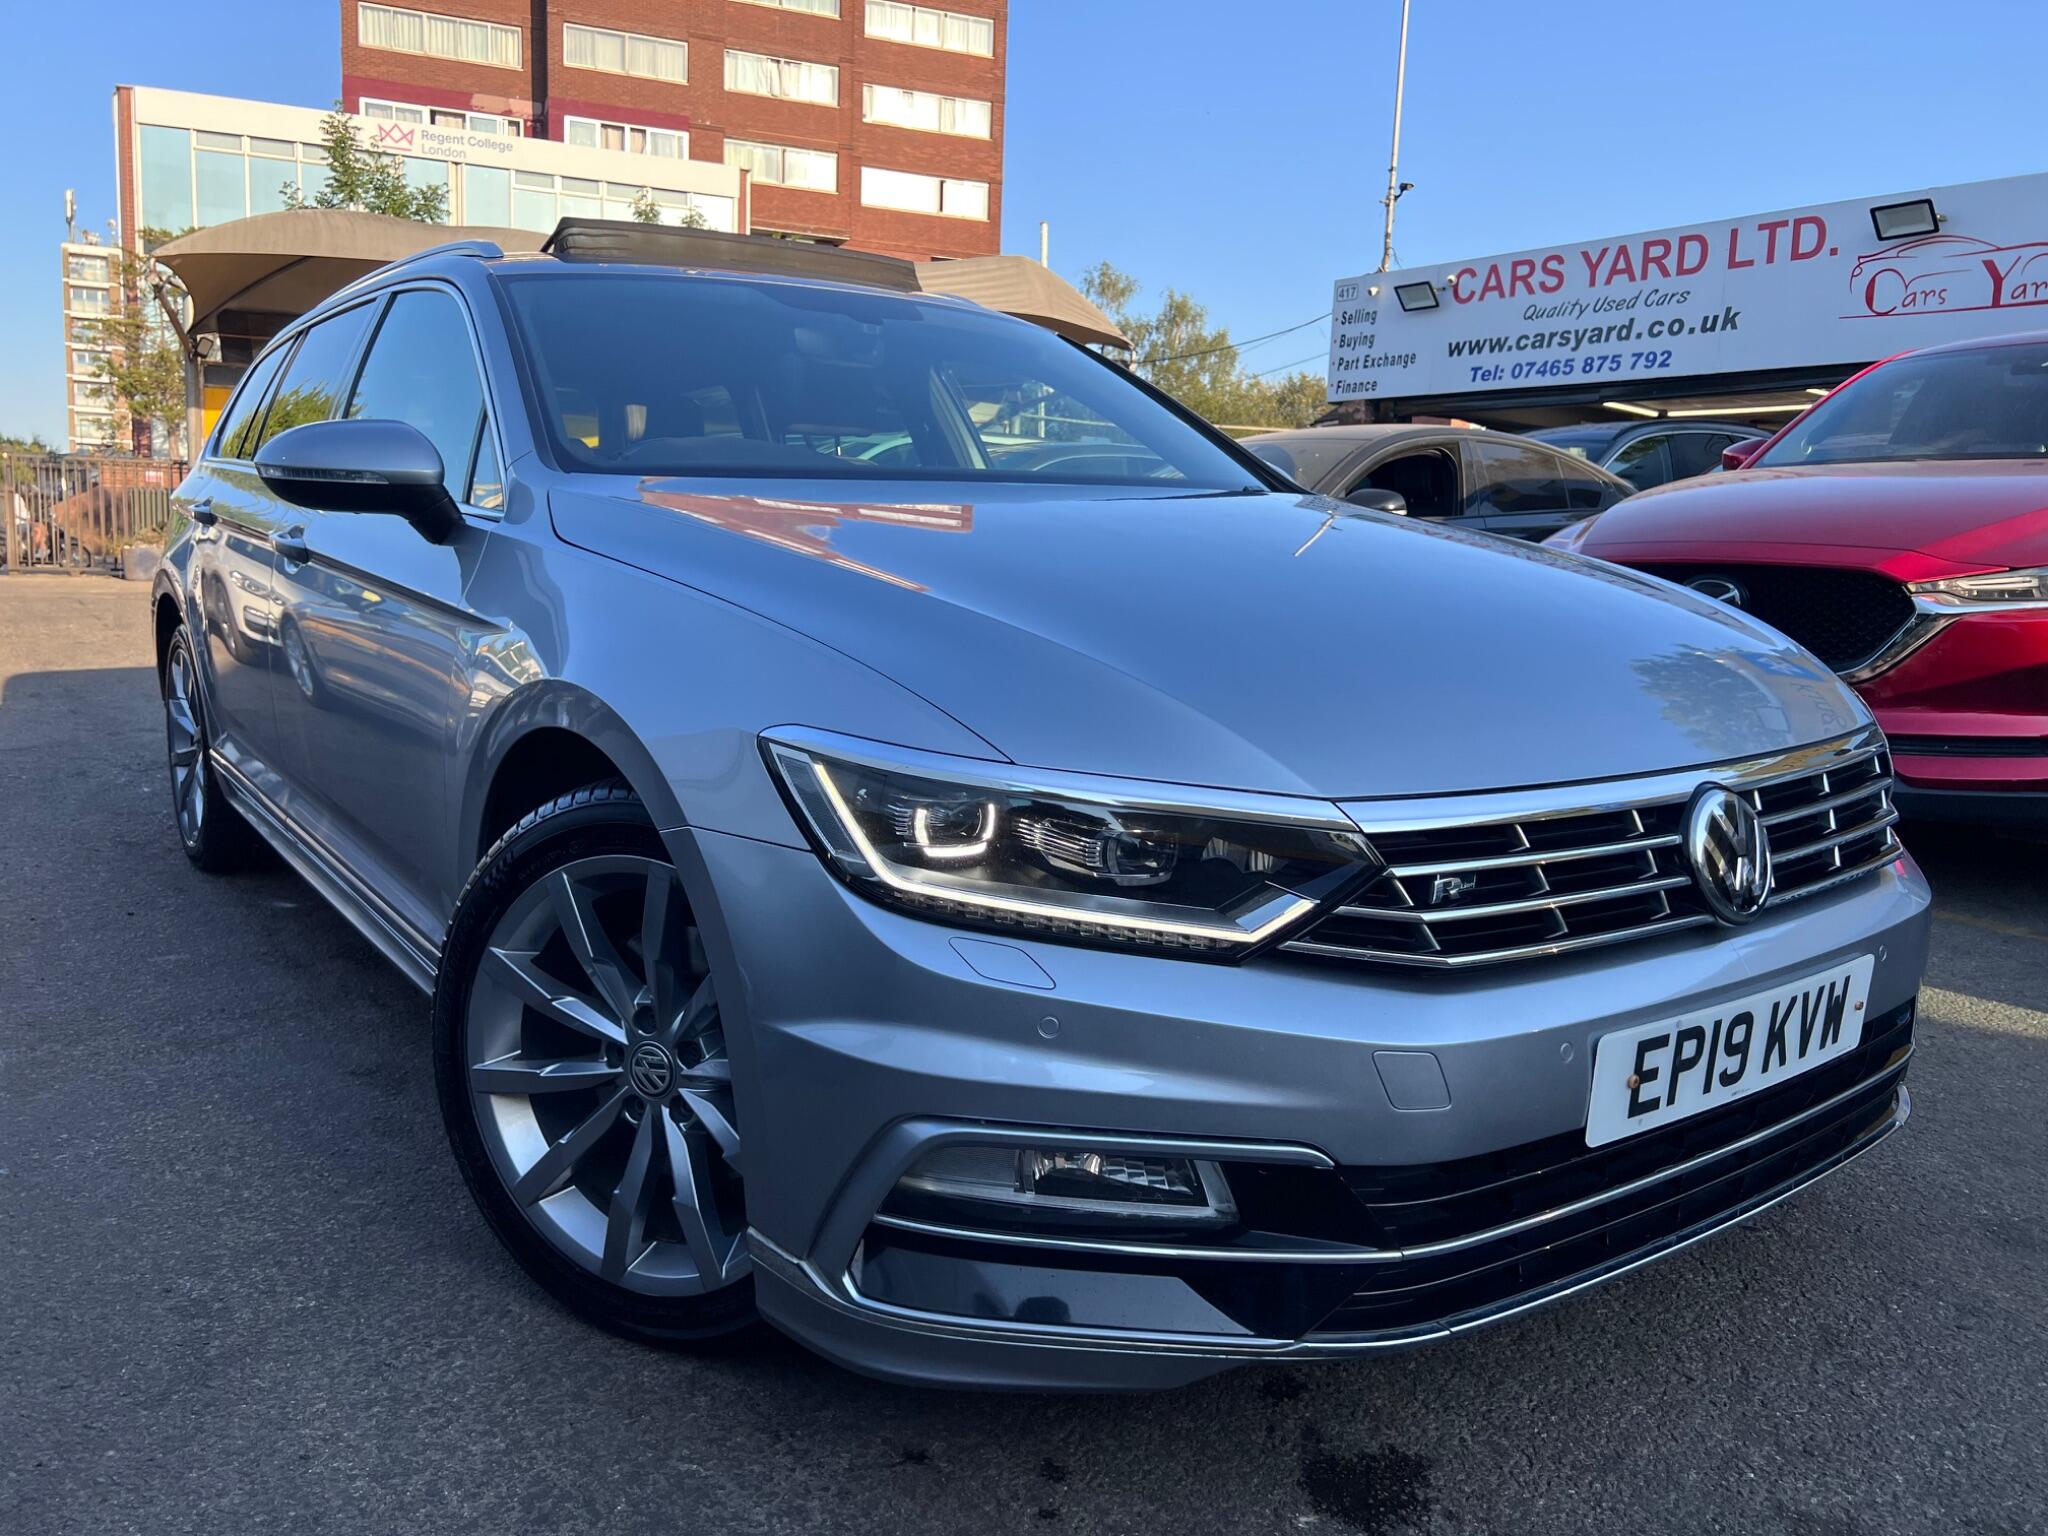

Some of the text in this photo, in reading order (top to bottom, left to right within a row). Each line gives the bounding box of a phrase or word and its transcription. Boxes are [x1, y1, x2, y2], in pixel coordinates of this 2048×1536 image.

[421, 129, 513, 153] Regent College
[421, 143, 466, 159] London
[1453, 215, 1839, 305] CARS YARD LTD.
[1338, 286, 1358, 300] 417
[1865, 268, 1948, 315] Cars
[1523, 288, 1691, 321] Quality Used Cars
[1340, 308, 1377, 326] Selling
[1339, 332, 1375, 351] Buying
[1448, 306, 1742, 357] www.carsyard.co.uk
[1337, 351, 1416, 371] Part Exchange
[1470, 350, 1673, 383] Tel: 07465 875 792
[1335, 379, 1377, 395] Finance
[1627, 974, 1852, 1119] EP19 KVW
